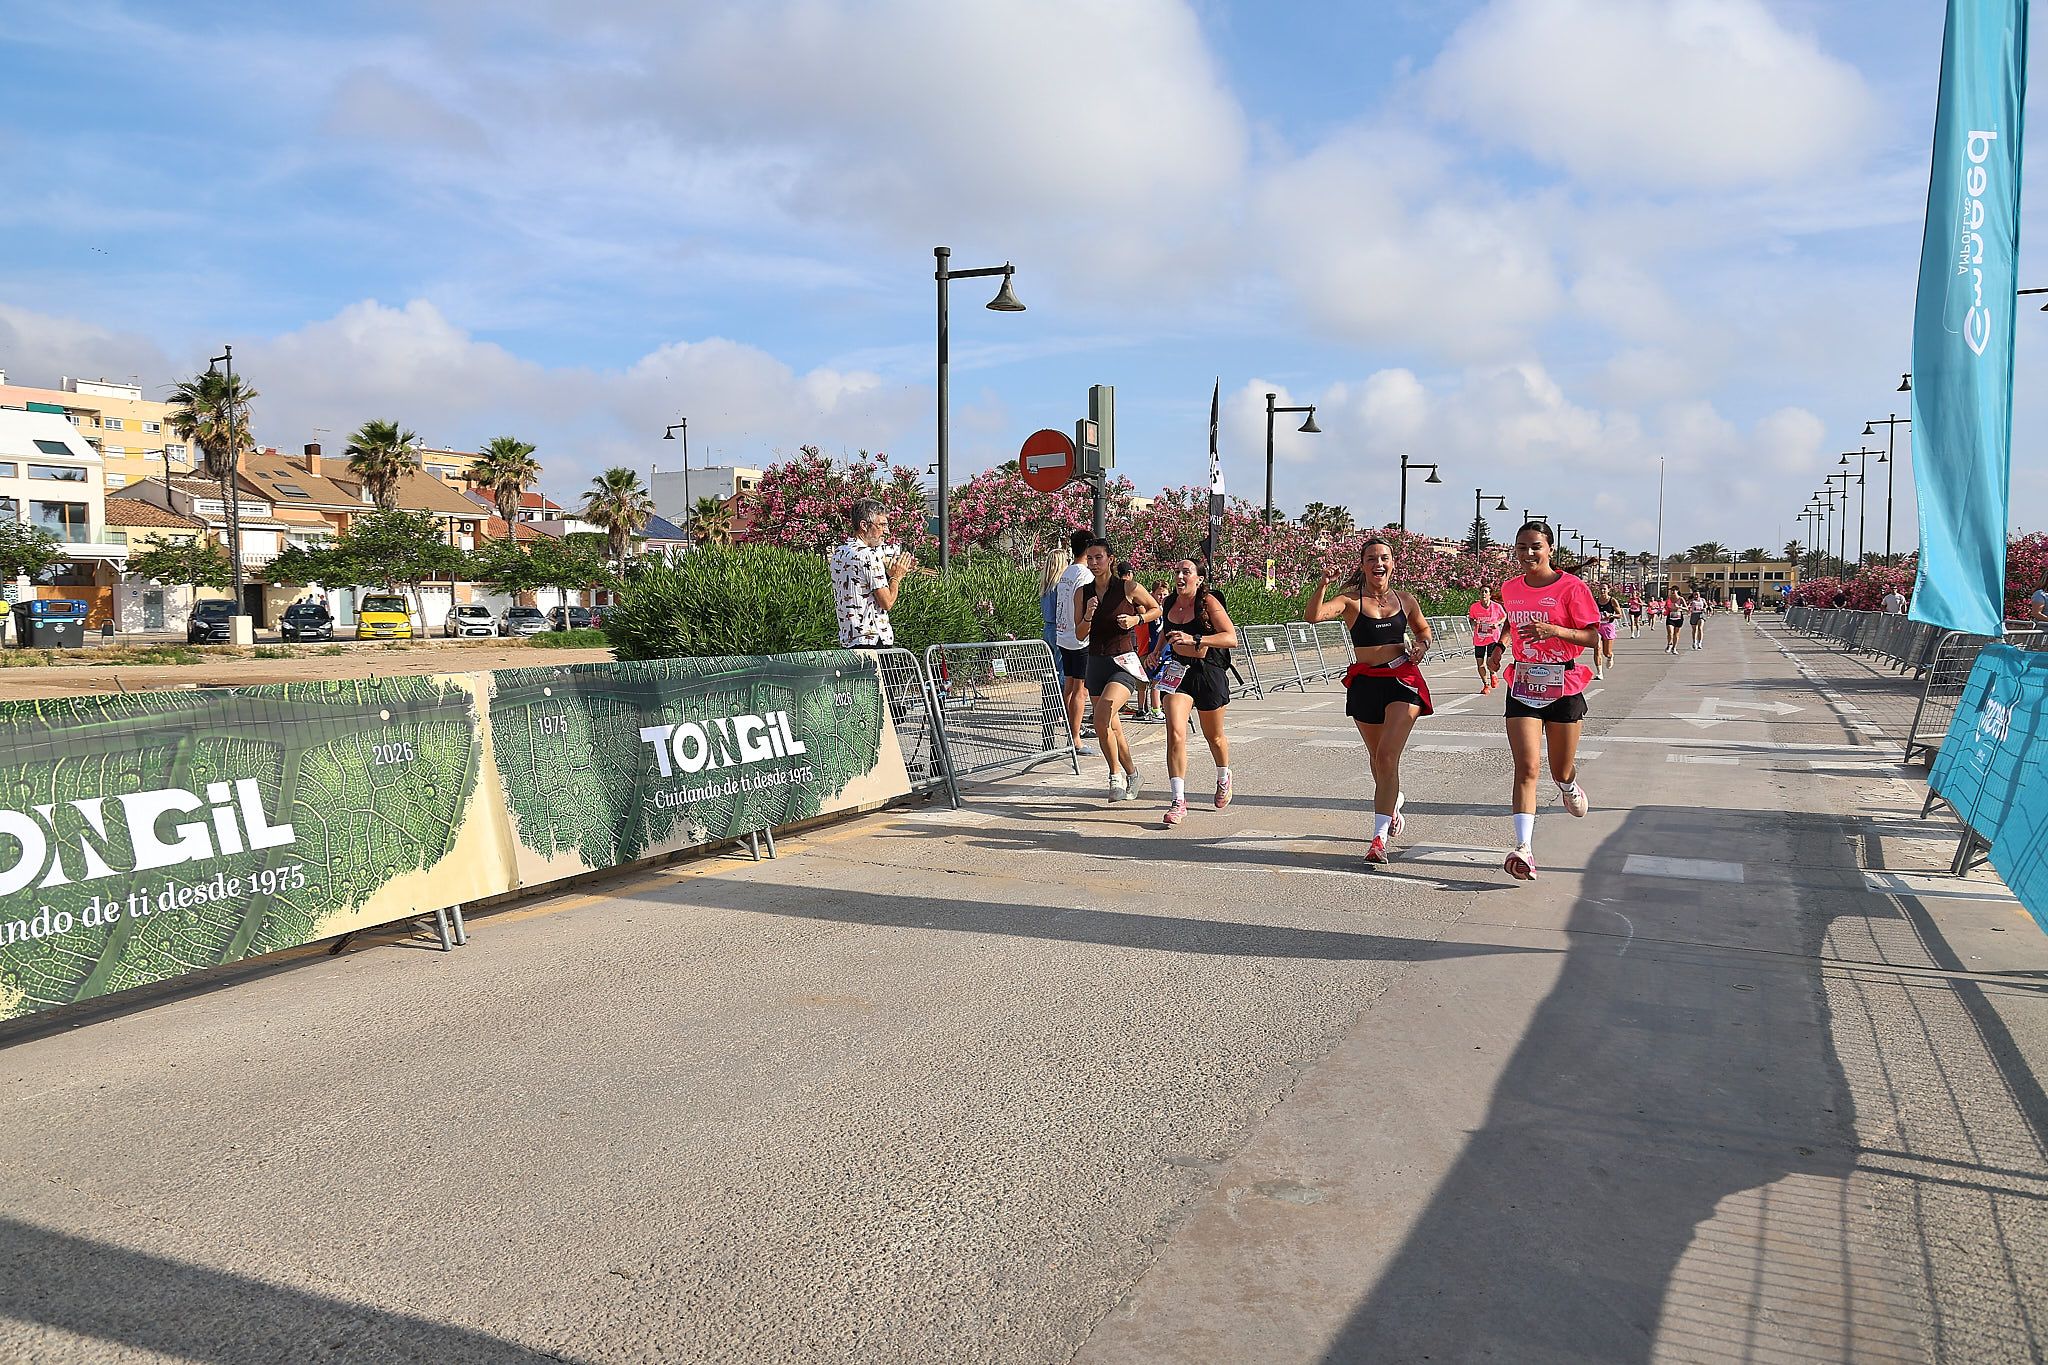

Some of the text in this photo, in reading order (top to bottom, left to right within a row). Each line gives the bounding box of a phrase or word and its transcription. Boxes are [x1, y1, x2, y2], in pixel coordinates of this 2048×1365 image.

[1508, 611, 1549, 624] CARRERA
[1528, 683, 1547, 692] 016
[833, 692, 853, 707] 2026
[537, 714, 568, 736] 1975
[372, 742, 414, 766] 2026
[655, 766, 813, 809] Cuidando de ti desde 1975
[0, 863, 305, 946] ndo de ti desde 1975
